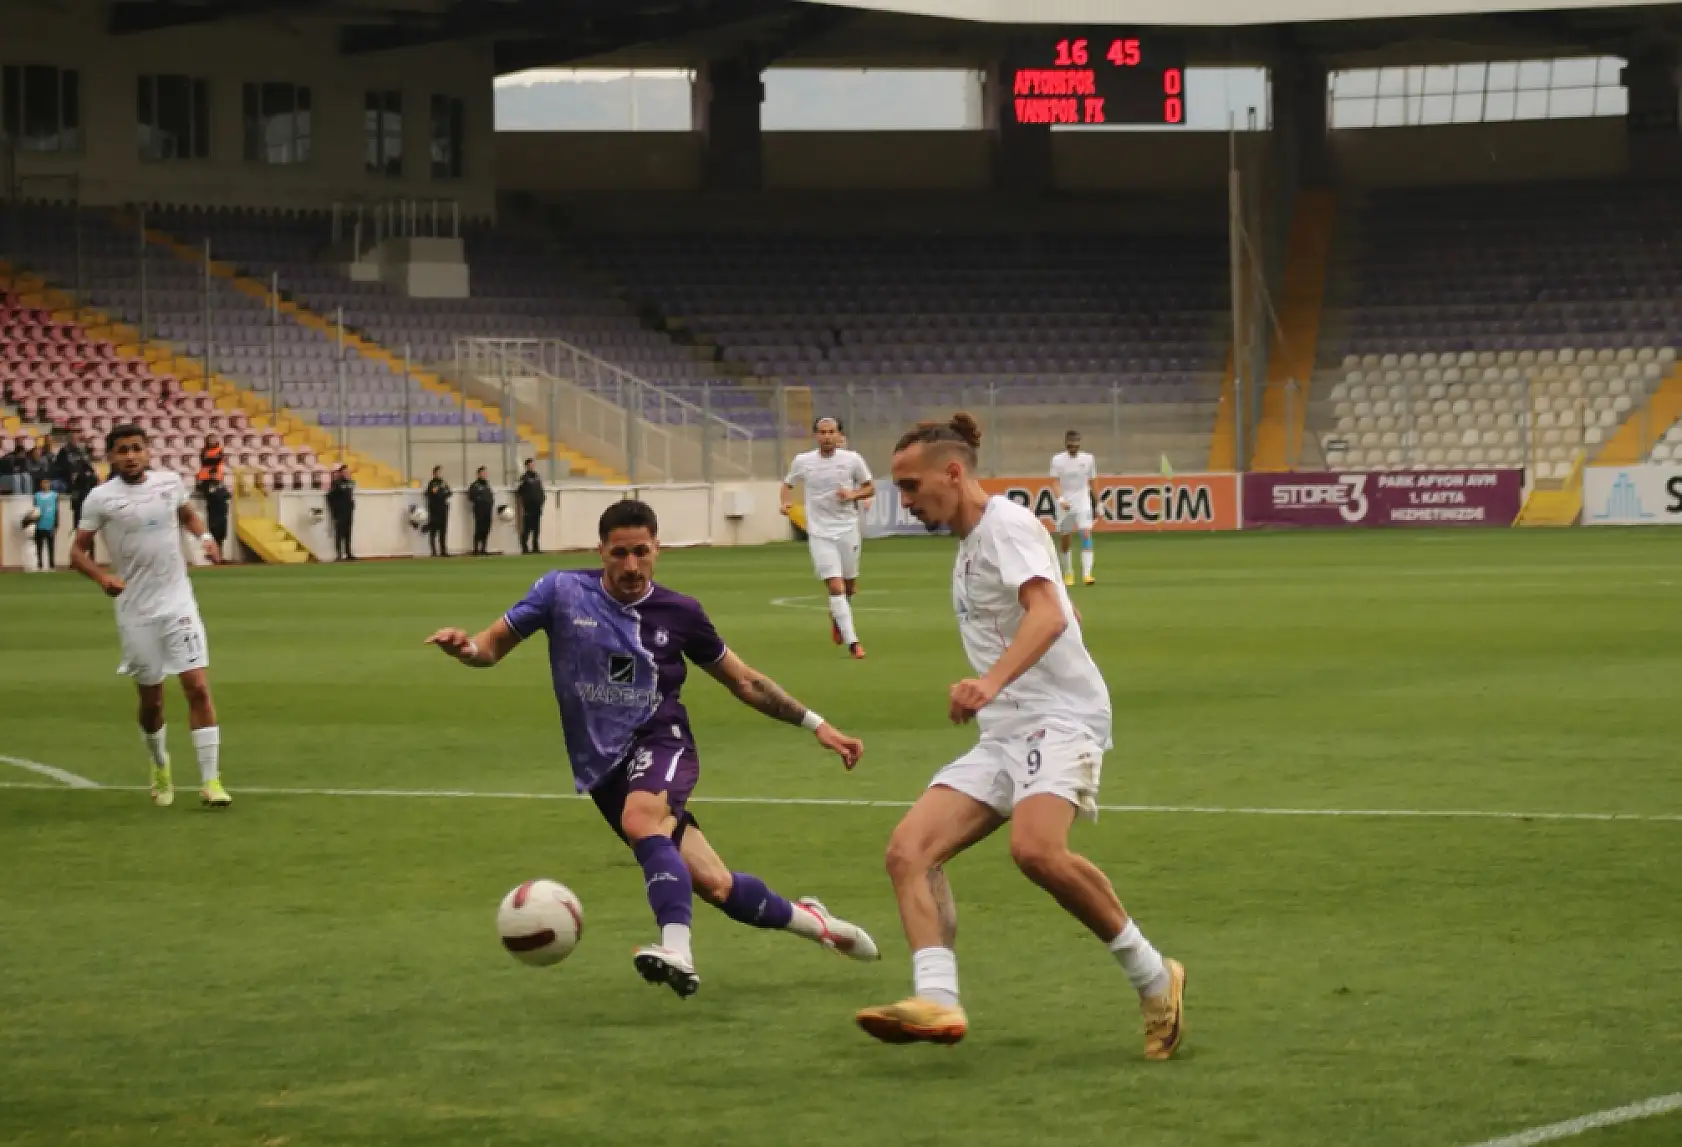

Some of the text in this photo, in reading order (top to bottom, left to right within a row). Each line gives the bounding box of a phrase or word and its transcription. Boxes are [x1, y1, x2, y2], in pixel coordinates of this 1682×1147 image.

[1055, 39, 1140, 65] 16 45
[1164, 68, 1181, 94] 0
[1165, 97, 1182, 123] 0
[1027, 749, 1041, 775] 9
